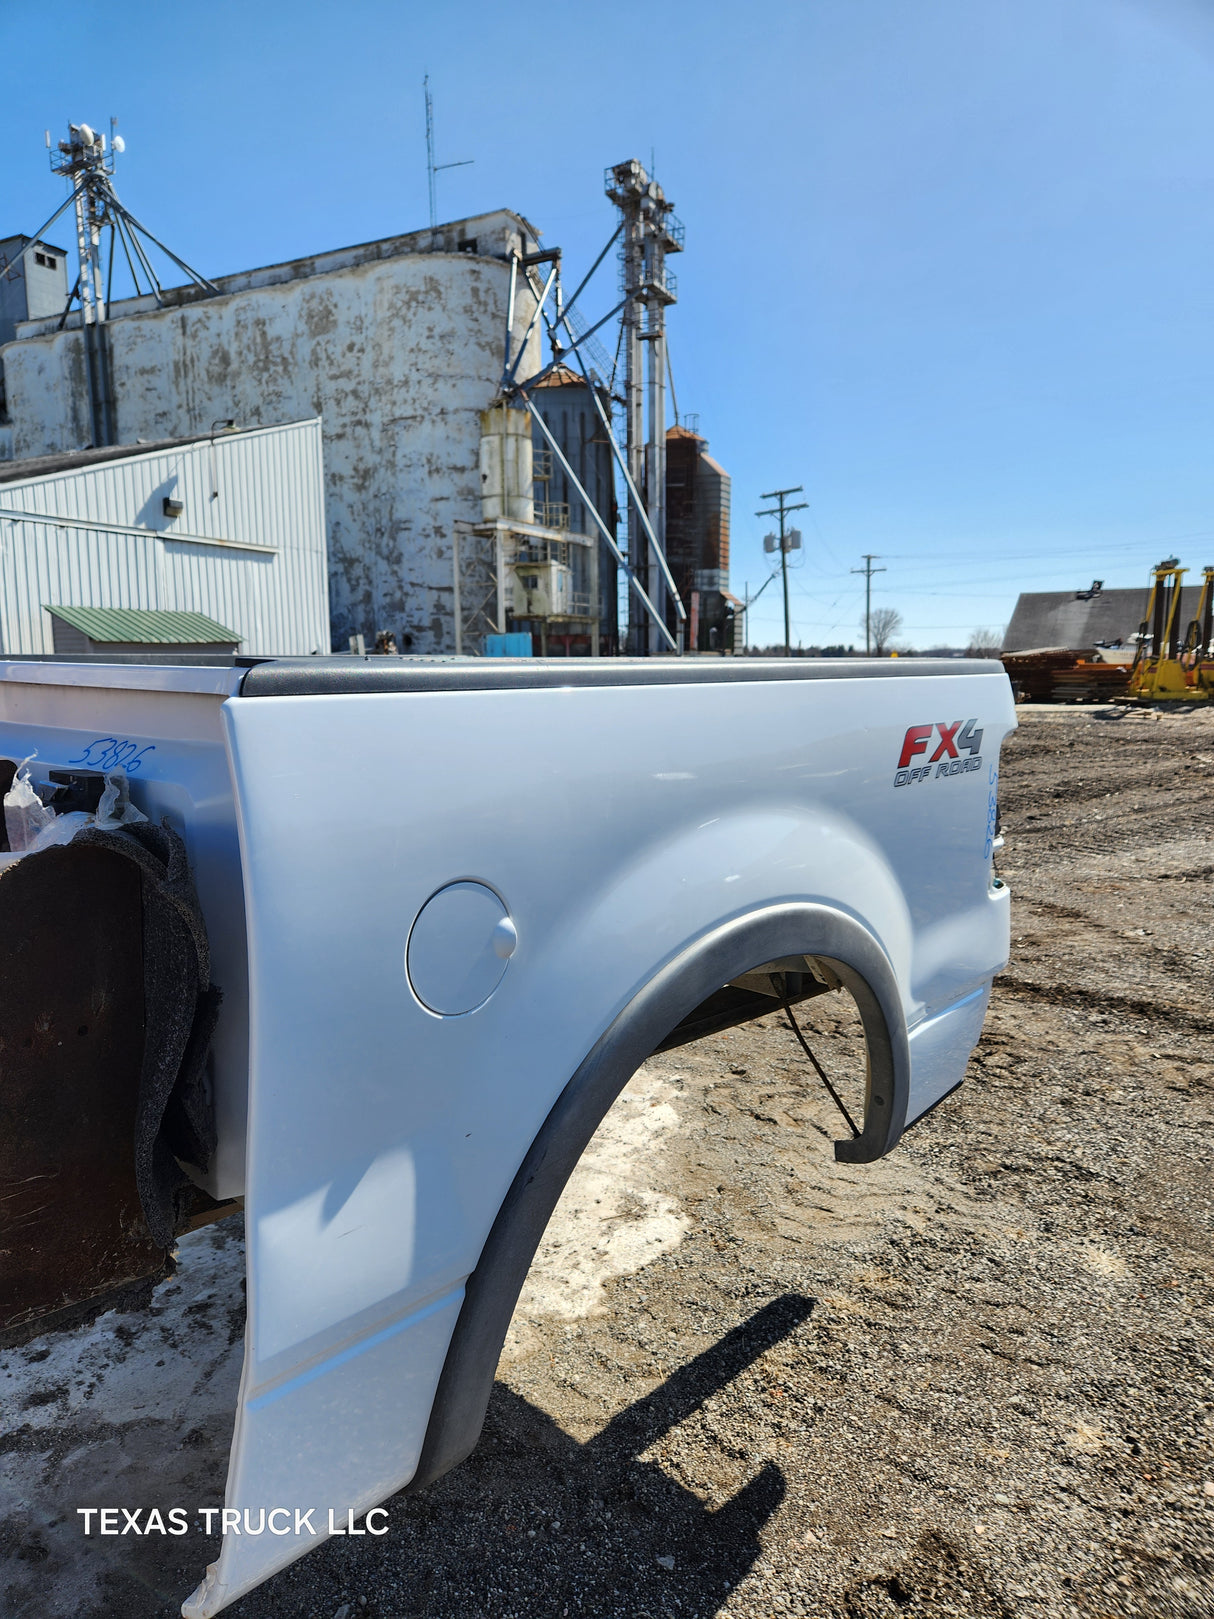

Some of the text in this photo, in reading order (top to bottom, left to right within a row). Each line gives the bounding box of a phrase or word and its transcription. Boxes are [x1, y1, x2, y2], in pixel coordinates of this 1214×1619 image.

[69, 737, 156, 773] 53826
[897, 719, 984, 769] FX4
[893, 756, 983, 788] OFF ROAD
